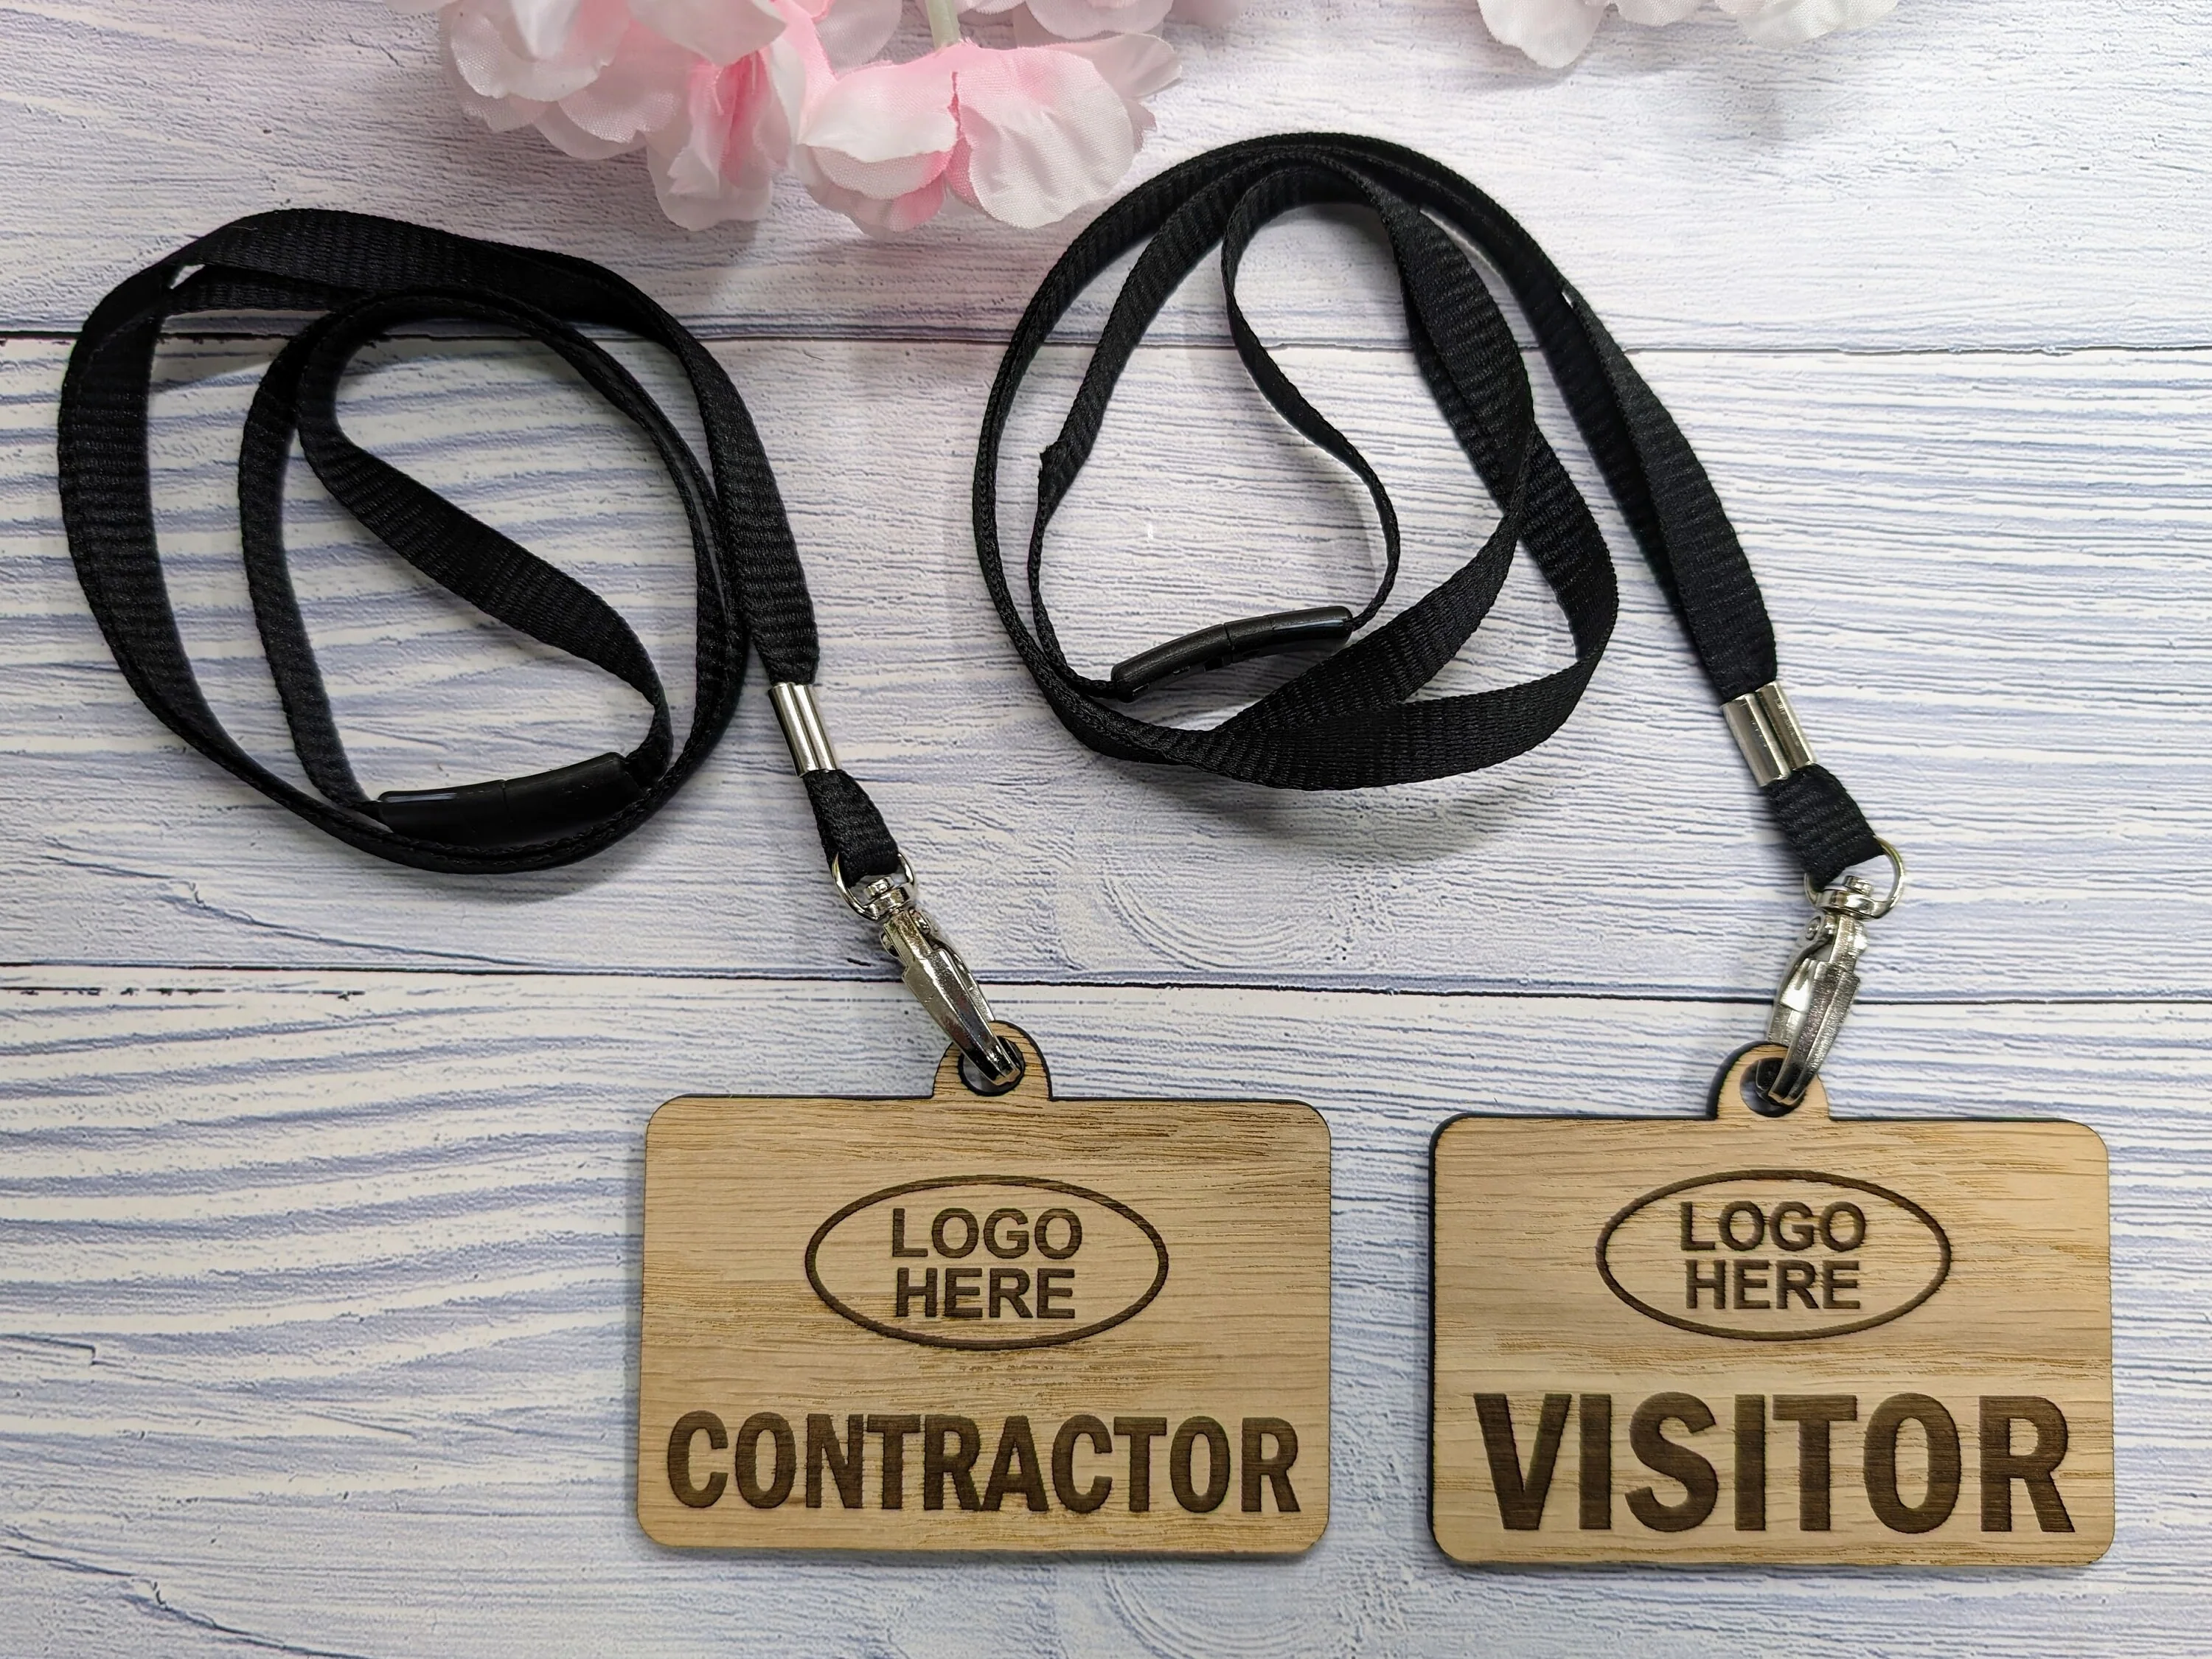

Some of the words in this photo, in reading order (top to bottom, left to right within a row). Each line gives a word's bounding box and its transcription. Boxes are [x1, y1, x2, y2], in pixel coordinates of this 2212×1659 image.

[891, 1207, 1083, 1259] LOGO
[1679, 1200, 1866, 1253] LOGO
[895, 1267, 1076, 1320] HERE
[1684, 1259, 1862, 1310] HERE
[666, 1409, 1301, 1514] CONTRACTOR
[1472, 1391, 2076, 1534] VISITOR
